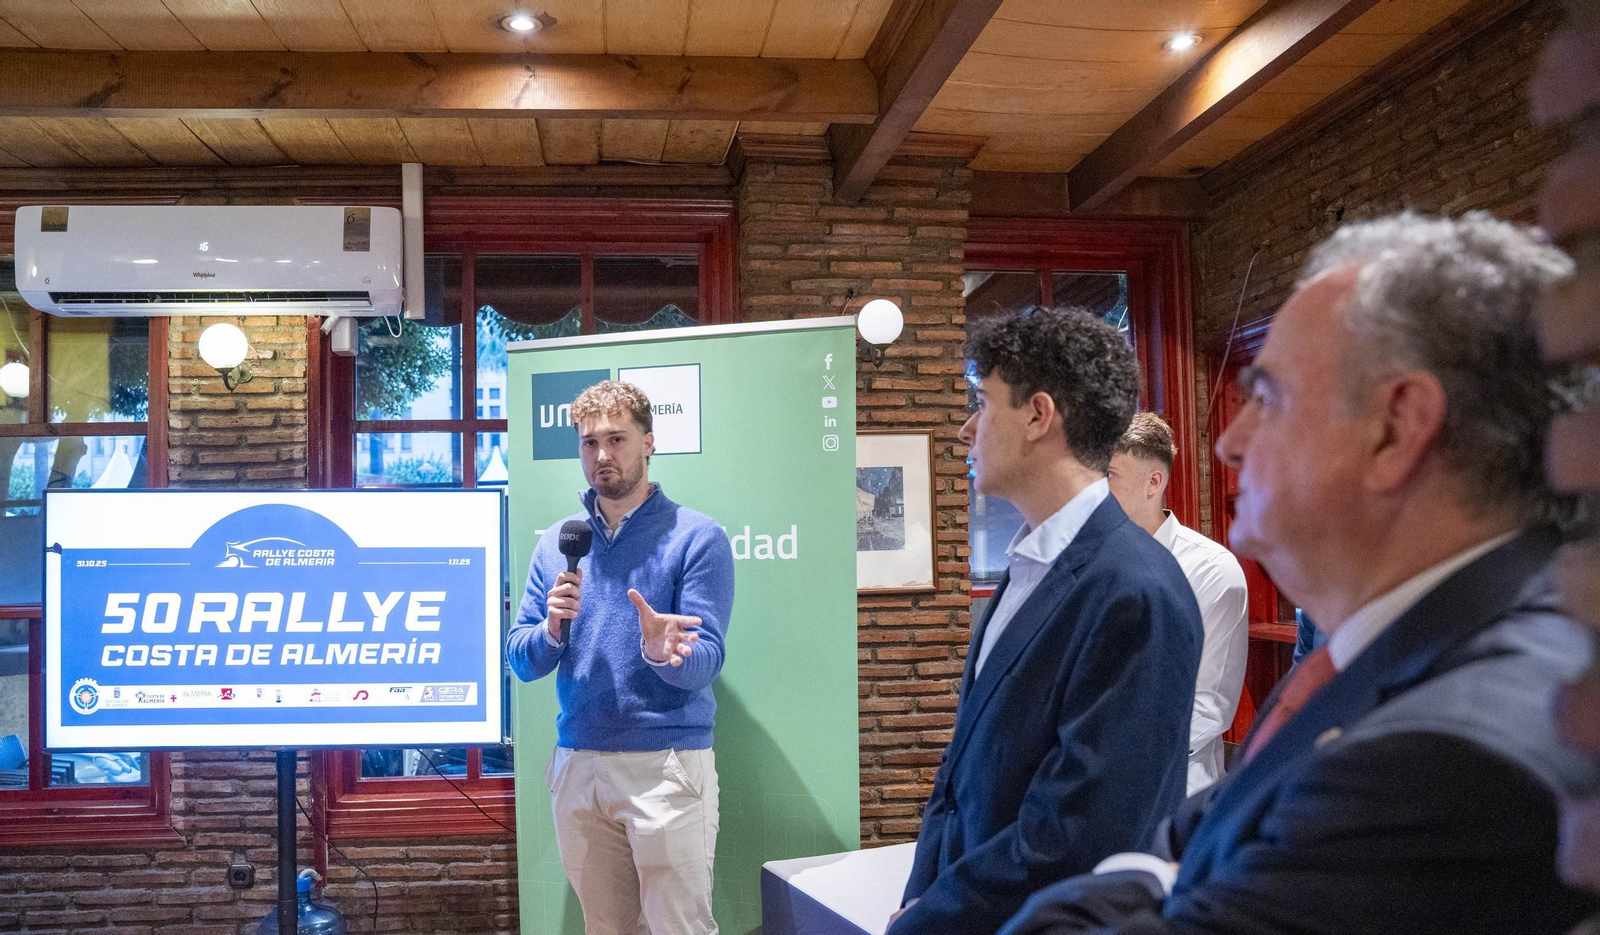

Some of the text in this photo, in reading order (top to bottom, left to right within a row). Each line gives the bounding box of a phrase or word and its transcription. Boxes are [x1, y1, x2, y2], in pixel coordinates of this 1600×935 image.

[199, 241, 209, 252] 16
[650, 403, 684, 416] MERÍA
[253, 549, 335, 557] RALLYE COSTA
[265, 558, 281, 566] DE
[101, 591, 447, 634] 50 RALLYE
[101, 637, 442, 667] COSTA DE ALMERÍA
